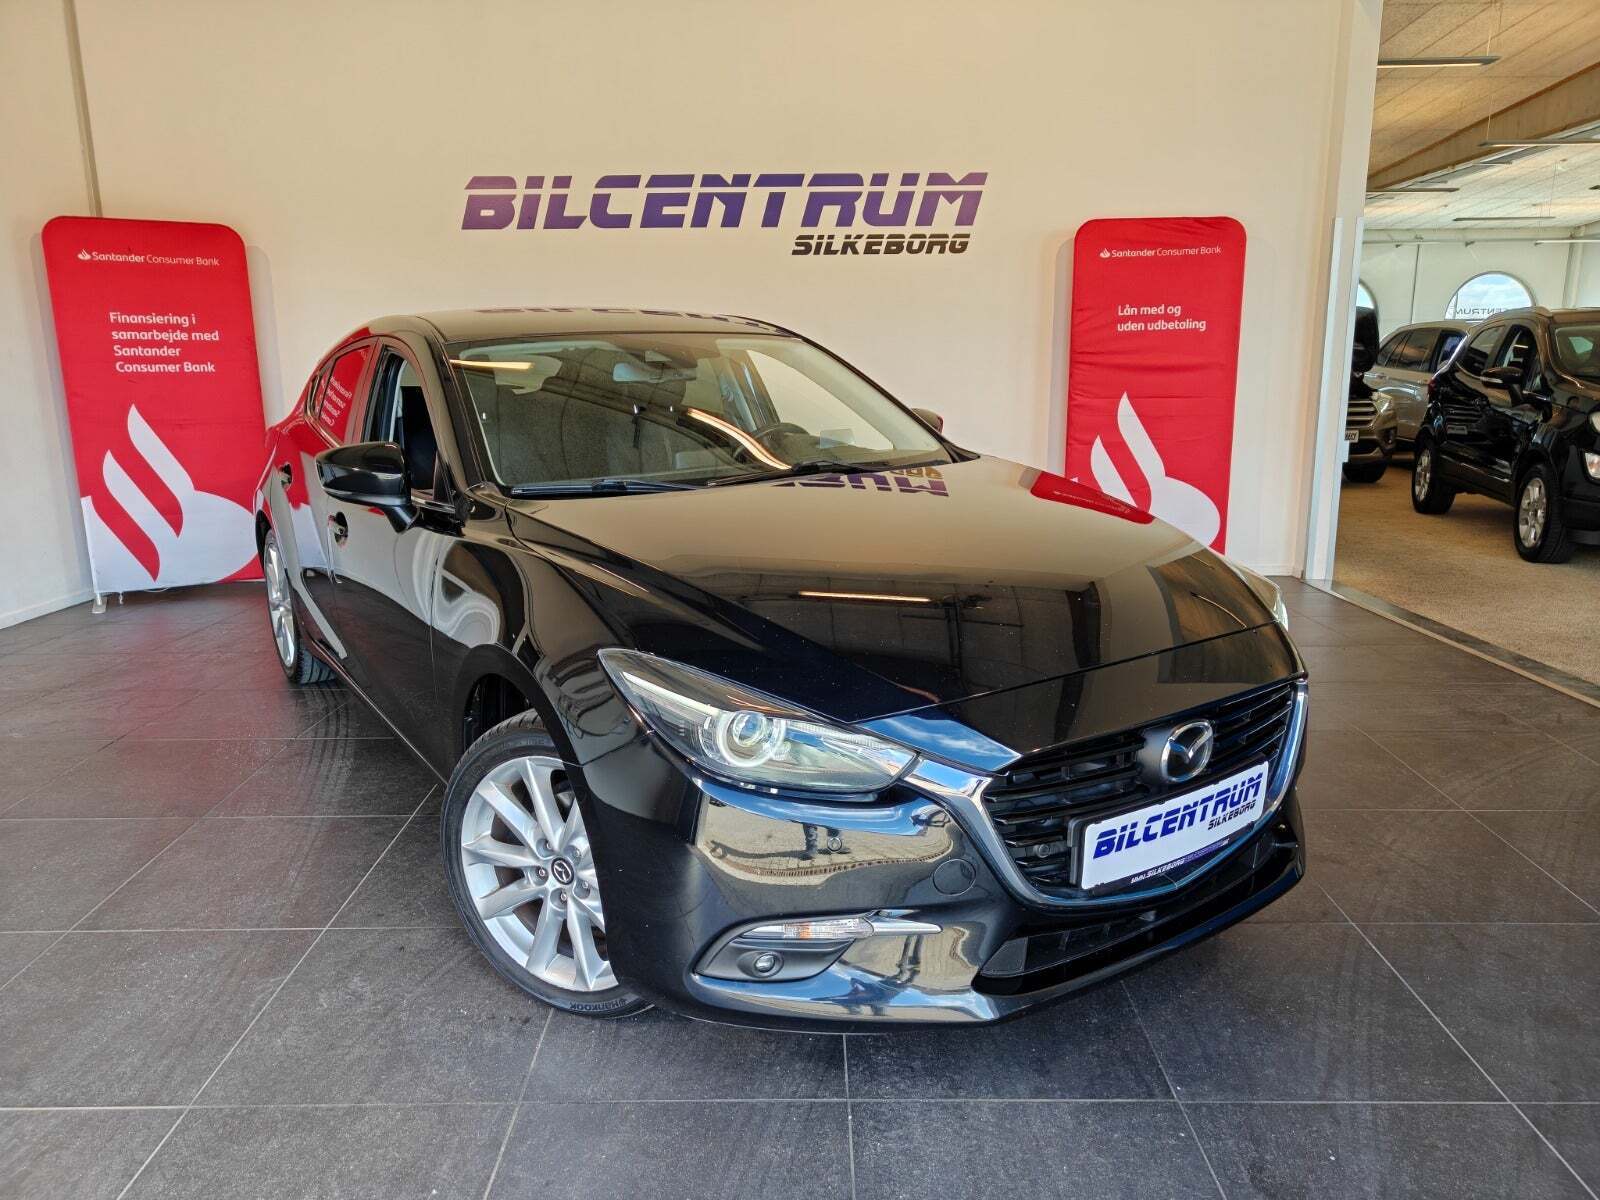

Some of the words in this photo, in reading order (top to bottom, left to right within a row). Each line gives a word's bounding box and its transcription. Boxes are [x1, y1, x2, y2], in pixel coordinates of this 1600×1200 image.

[461, 172, 988, 230] BILCENTRUM
[791, 233, 971, 256] SILKEBORG
[1111, 248, 1155, 257] Santander
[1156, 246, 1199, 257] Consumer
[1200, 245, 1221, 255] Bank
[91, 251, 145, 263] Santander
[146, 254, 194, 265] Consumer
[196, 257, 220, 266] Bank
[1118, 304, 1137, 316] Lån
[1140, 304, 1164, 315] med
[1167, 305, 1182, 317] og
[109, 312, 189, 327] Finansiering
[191, 313, 196, 325] i
[1117, 321, 1144, 332] uden
[1147, 319, 1207, 332] udbetaling
[111, 329, 189, 343] samarbejde
[191, 330, 219, 341] med
[113, 345, 181, 357] Santander
[115, 361, 180, 373] Consumer
[183, 361, 216, 373] Bank
[1093, 772, 1263, 860] BILCENTRUM
[1207, 799, 1257, 831] SILKEBORG
